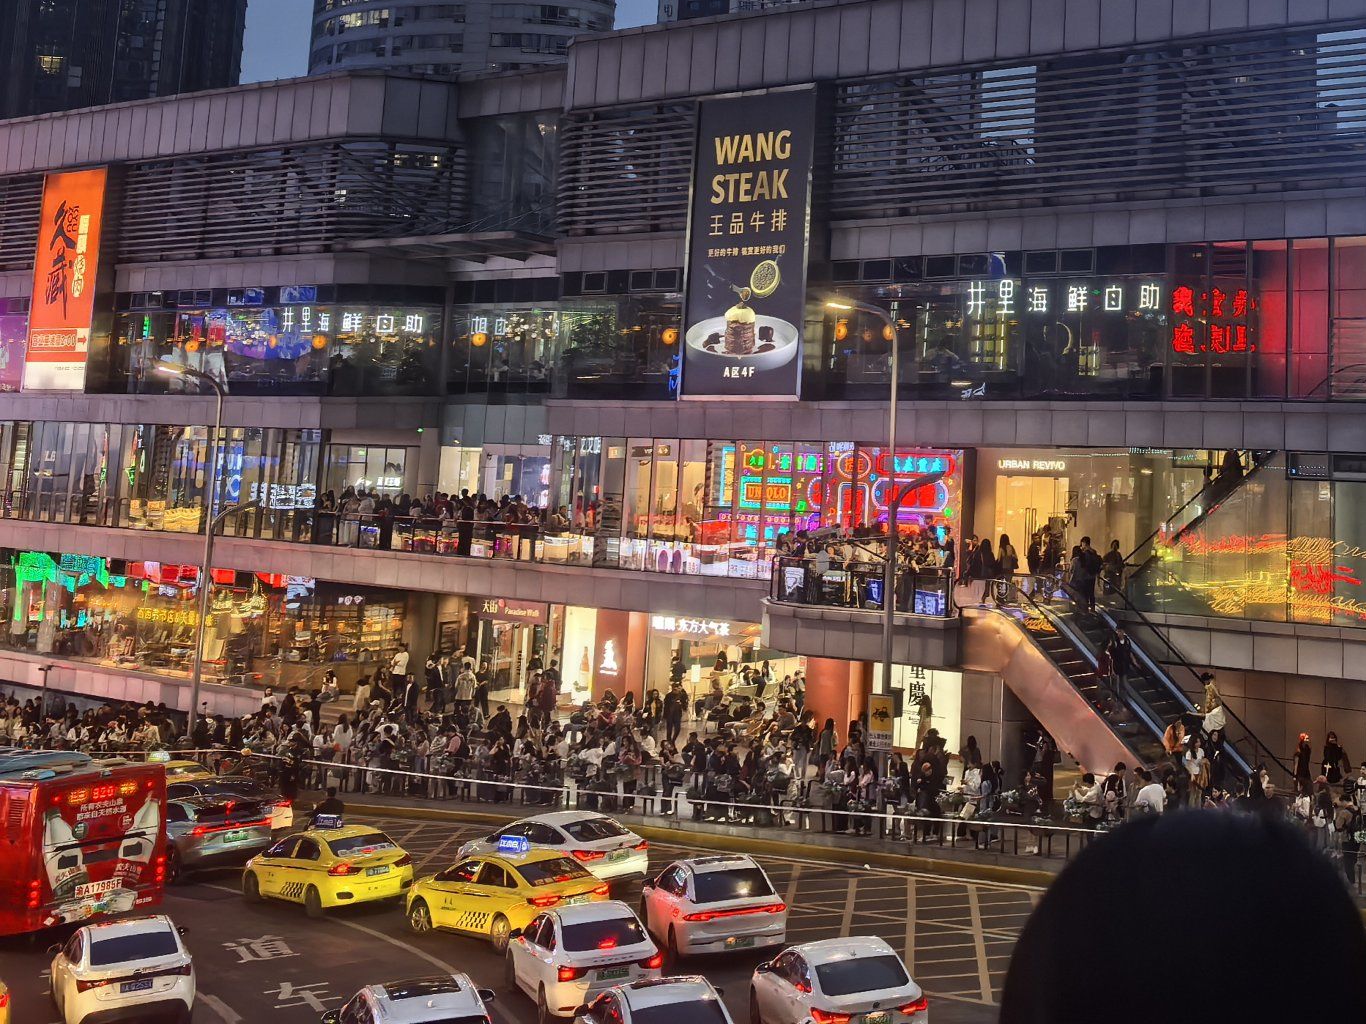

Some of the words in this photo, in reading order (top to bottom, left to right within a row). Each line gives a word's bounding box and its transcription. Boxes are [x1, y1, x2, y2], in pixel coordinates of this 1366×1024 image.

[714, 129, 792, 166] WANG
[711, 169, 788, 204] STEAK
[709, 209, 787, 237] 王品牛排
[998, 459, 1030, 470] URBAN
[1033, 460, 1066, 471] REVIVO
[747, 484, 787, 500] UNQLO
[482, 599, 498, 613] 天街
[75, 878, 123, 897] 渝A17985F
[221, 934, 301, 964] 道
[263, 981, 342, 1013] 车
